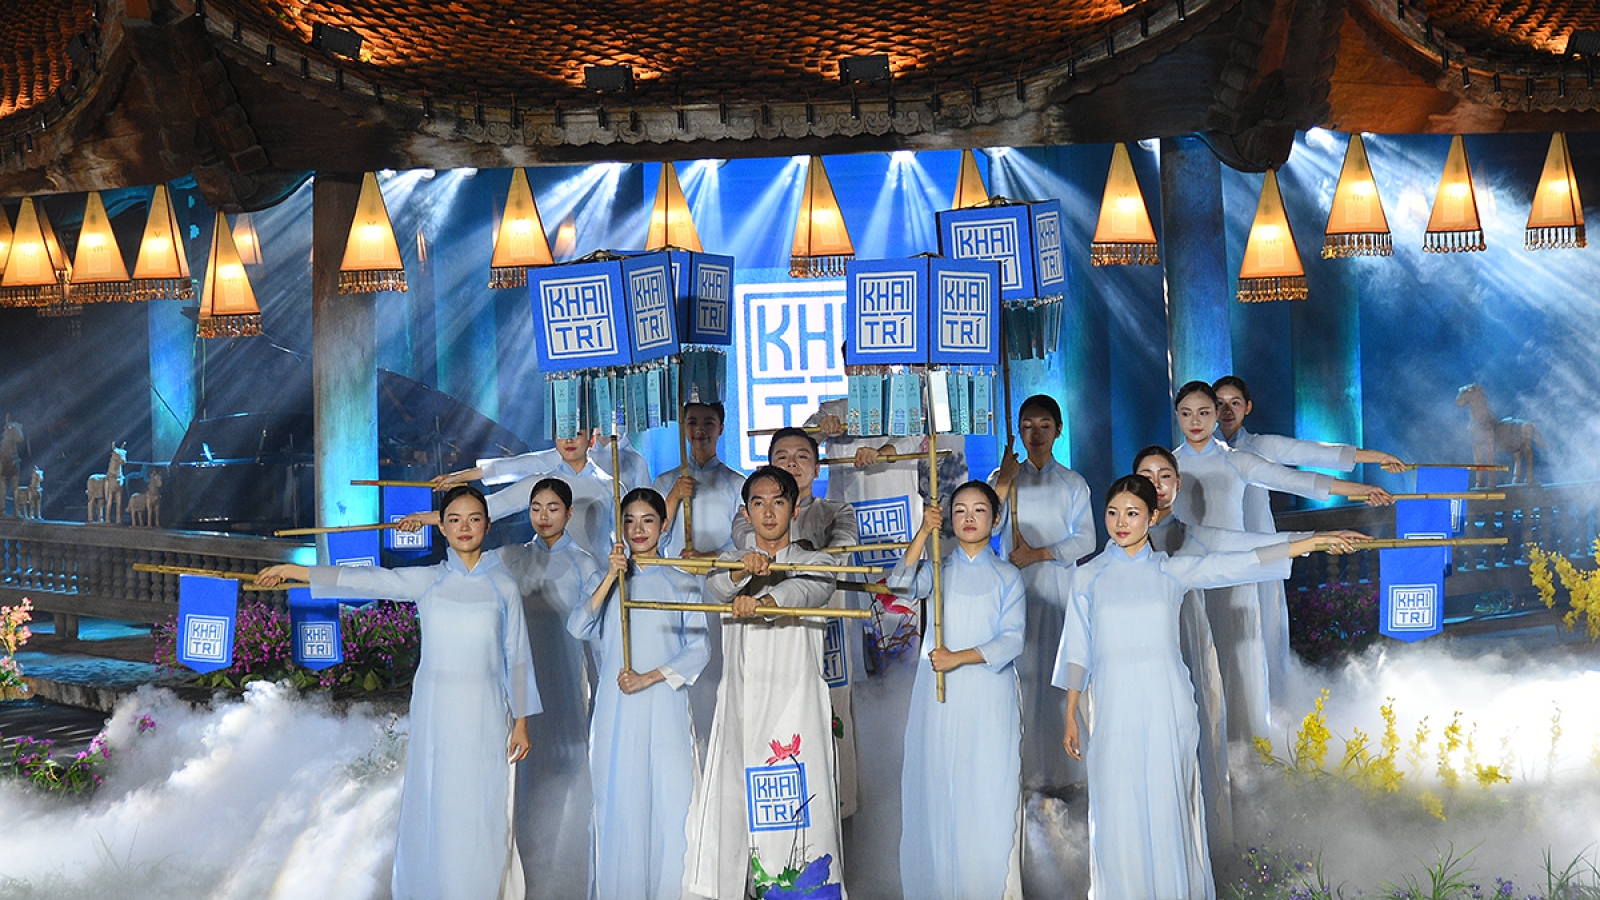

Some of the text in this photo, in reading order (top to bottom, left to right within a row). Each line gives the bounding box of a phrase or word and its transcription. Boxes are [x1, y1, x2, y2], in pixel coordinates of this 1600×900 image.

[960, 227, 1011, 255] KHAI
[549, 284, 605, 318] KHAI
[634, 274, 665, 310] KHAI
[863, 281, 909, 311] KHAI
[945, 280, 984, 311] KHAI
[640, 311, 665, 340] TRÍ
[701, 305, 723, 327] TRÍ
[555, 321, 603, 350] TRÍ
[757, 303, 847, 371] KH
[865, 317, 906, 344] TRÍ
[946, 318, 981, 344] TRÍ
[860, 508, 903, 535] KHAI
[1399, 593, 1429, 607] KHAI
[192, 623, 220, 638] KHAI
[756, 774, 796, 798] KHAI
